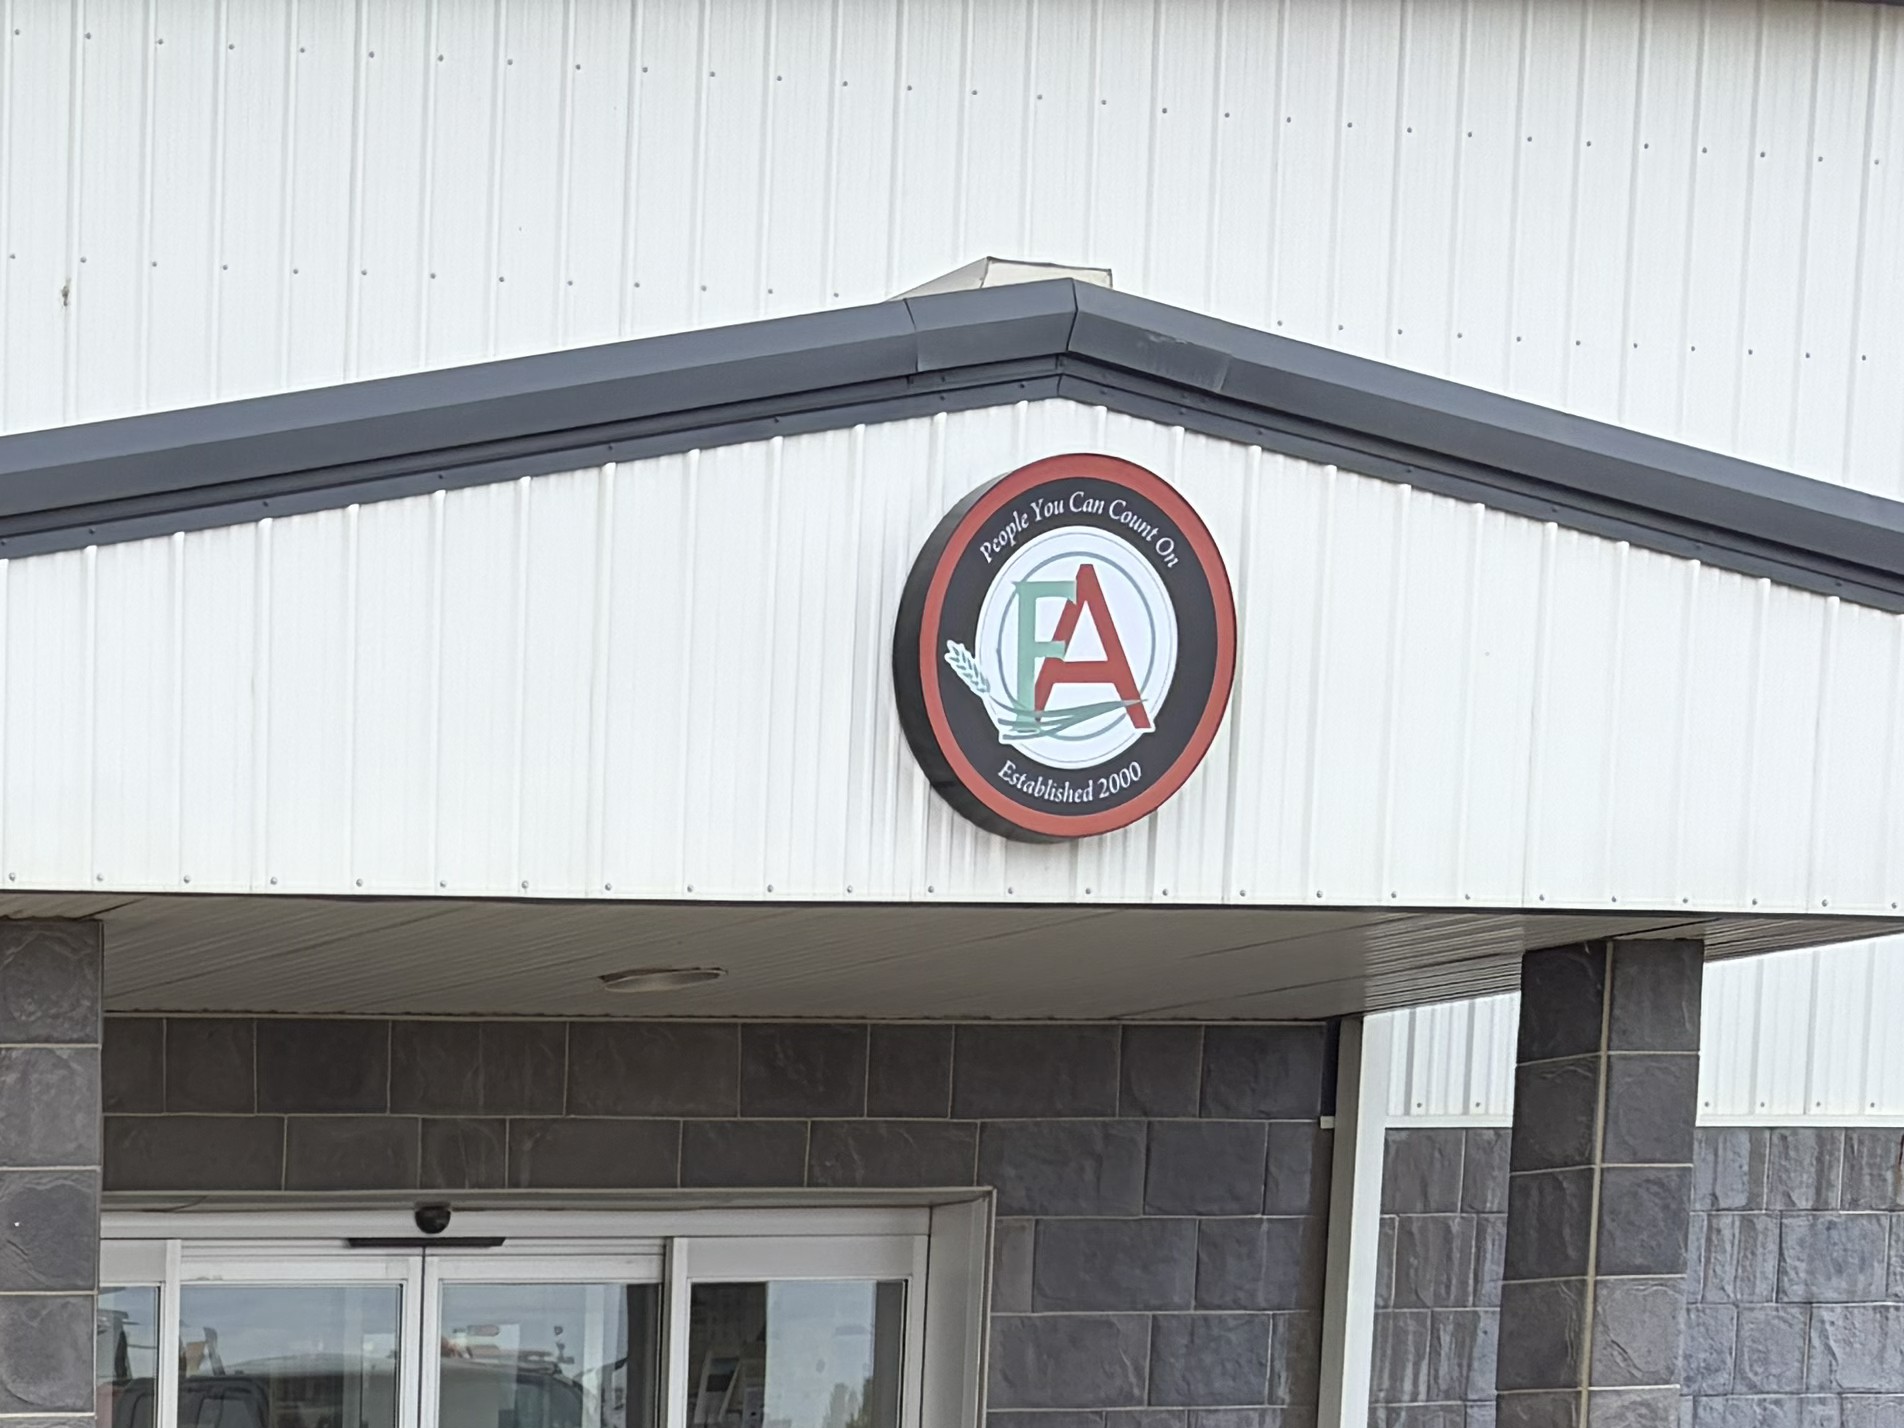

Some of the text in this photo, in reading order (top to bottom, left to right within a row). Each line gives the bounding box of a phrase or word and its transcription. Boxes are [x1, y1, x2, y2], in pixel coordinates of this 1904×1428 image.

[980, 491, 1179, 568] People You Can Count On
[997, 760, 1142, 803] Established 2000
